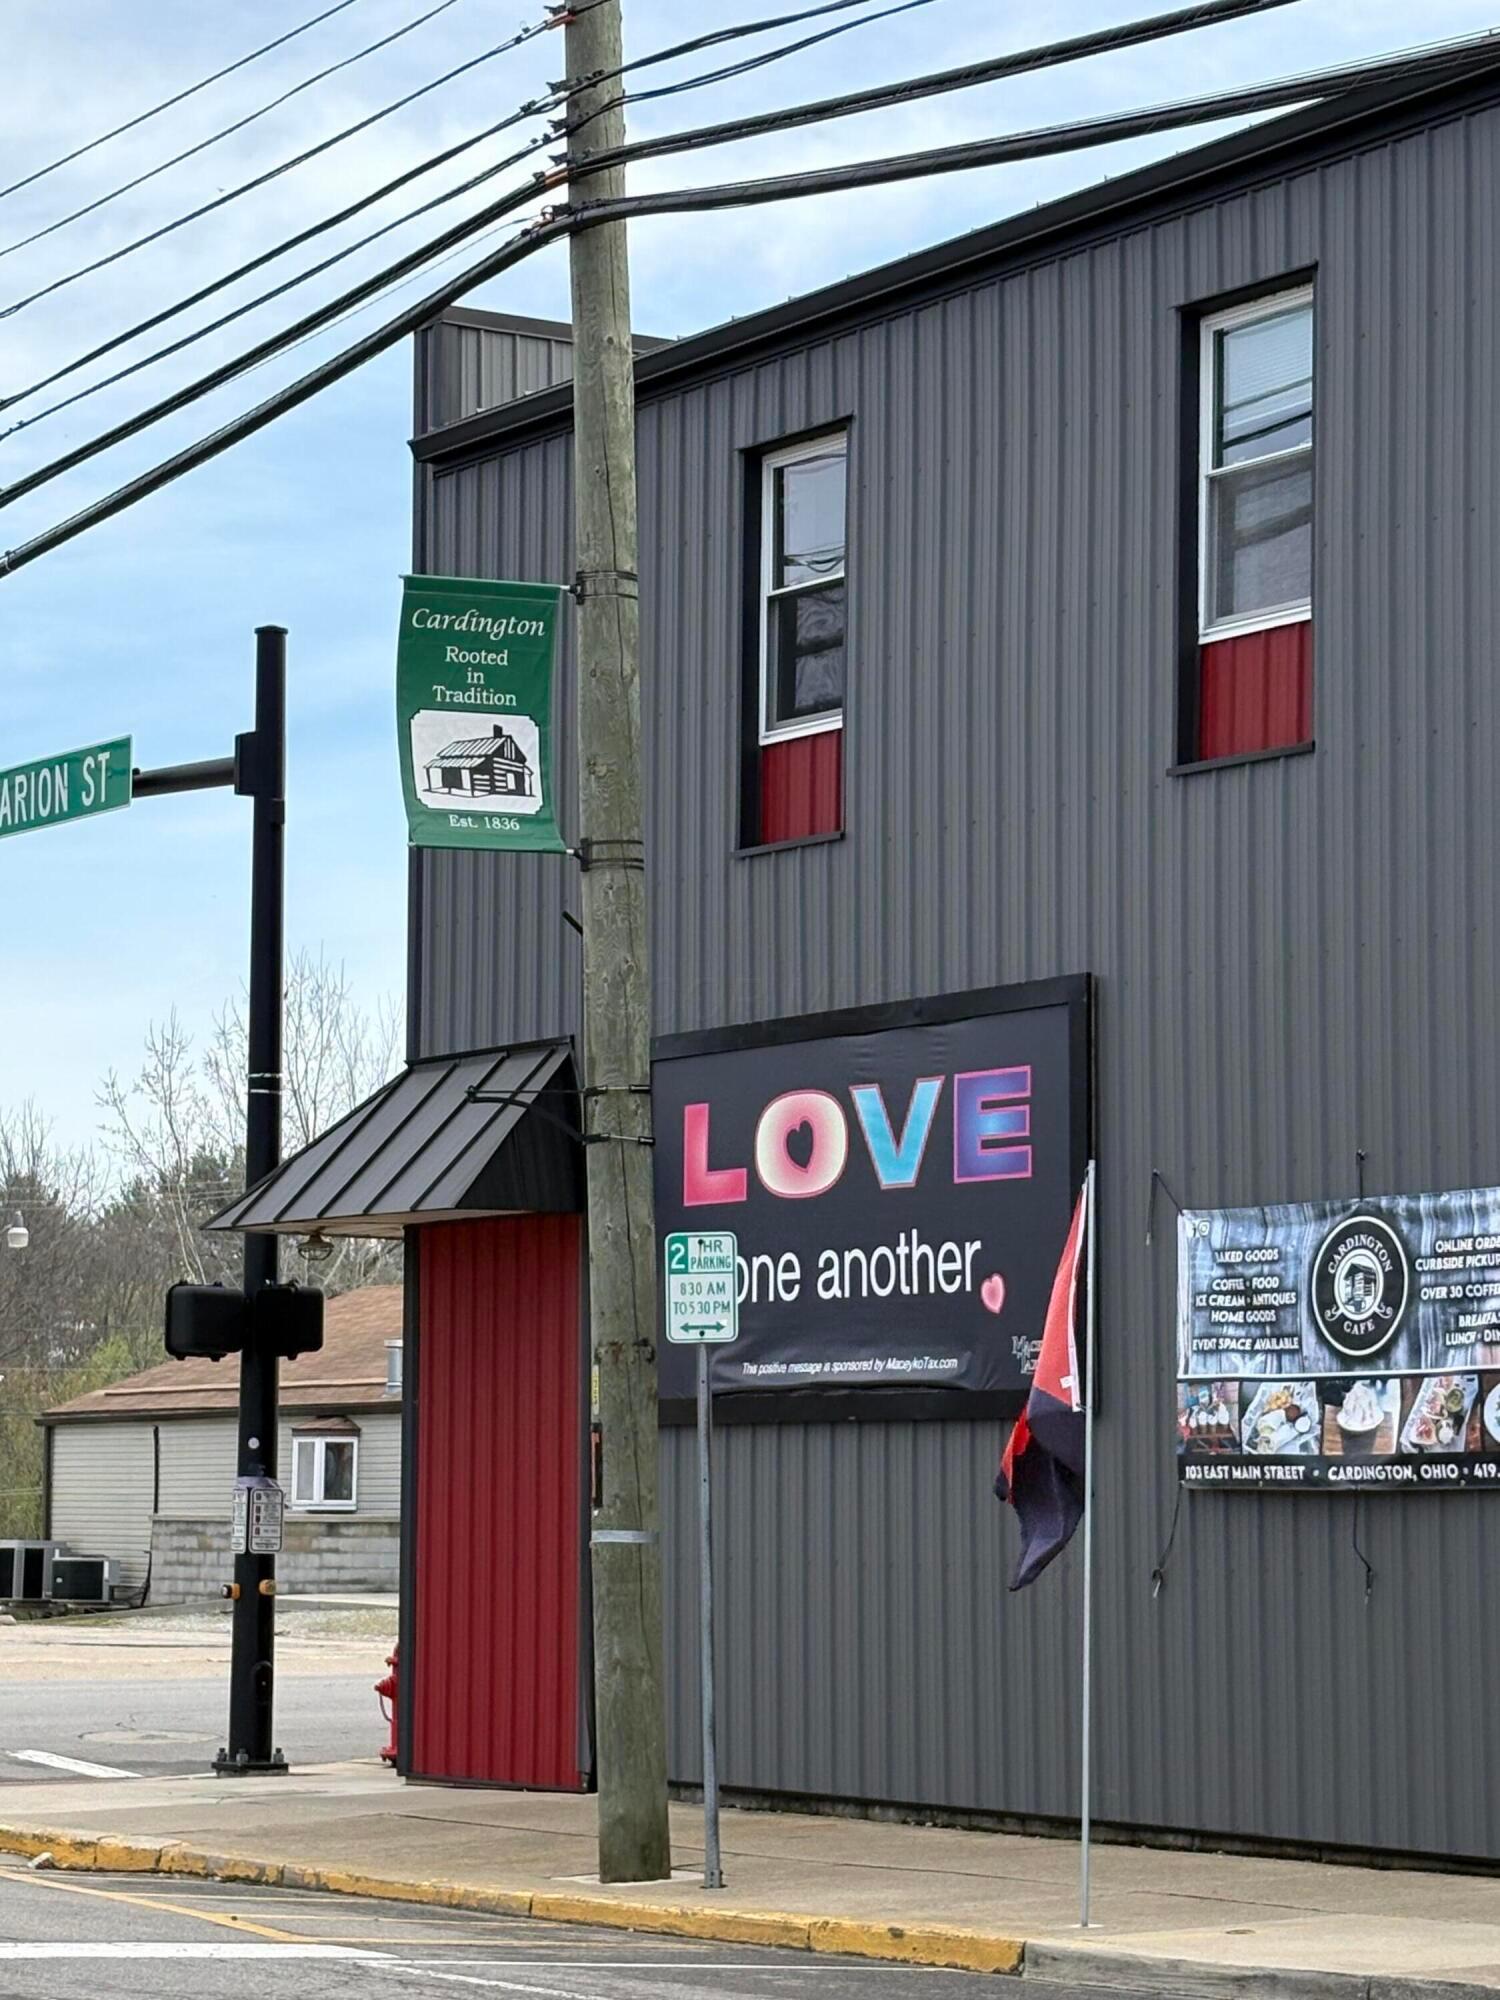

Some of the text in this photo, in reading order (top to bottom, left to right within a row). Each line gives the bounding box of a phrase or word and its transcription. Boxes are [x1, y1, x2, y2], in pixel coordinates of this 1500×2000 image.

[411, 608, 546, 641] Cardington
[445, 646, 509, 666] Rooted
[466, 667, 485, 684] in
[432, 685, 517, 706] Tradition
[0, 751, 110, 828] ARION ST
[449, 814, 521, 831] Est. 1836
[683, 1065, 1032, 1206] LOVE
[1435, 1237, 1473, 1253] ONLINE
[670, 1239, 723, 1270] 2 HR
[1245, 1248, 1279, 1262] GOODS
[1328, 1233, 1393, 1274] CARDINGTON
[690, 1256, 732, 1270] PARKING
[817, 1228, 982, 1301] another
[1415, 1256, 1464, 1271] CURBSIDE
[706, 1281, 726, 1296] AM
[1252, 1276, 1280, 1290] FOOD
[1208, 1293, 1246, 1307] CREAM
[1252, 1291, 1297, 1307] ANTIQUES
[1420, 1286, 1448, 1300] OVER
[1449, 1285, 1463, 1299] 30
[673, 1301, 688, 1315] TO
[713, 1301, 731, 1314] PM
[1211, 1309, 1277, 1323] HOME GOODS
[1343, 1319, 1375, 1335] CAFE
[1218, 1338, 1252, 1351] SPACE
[1253, 1337, 1299, 1351] AVAILABLE
[742, 1362, 758, 1375] This
[758, 1362, 787, 1376] positive
[787, 1362, 822, 1375] message
[831, 1358, 874, 1374] sponsored
[874, 1358, 886, 1373] by
[1203, 1465, 1229, 1480] EAST
[1231, 1465, 1262, 1480] MAIN
[1263, 1464, 1306, 1480] STREET
[1327, 1464, 1417, 1482] CARDINGTON,
[1420, 1463, 1459, 1479] OHIO
